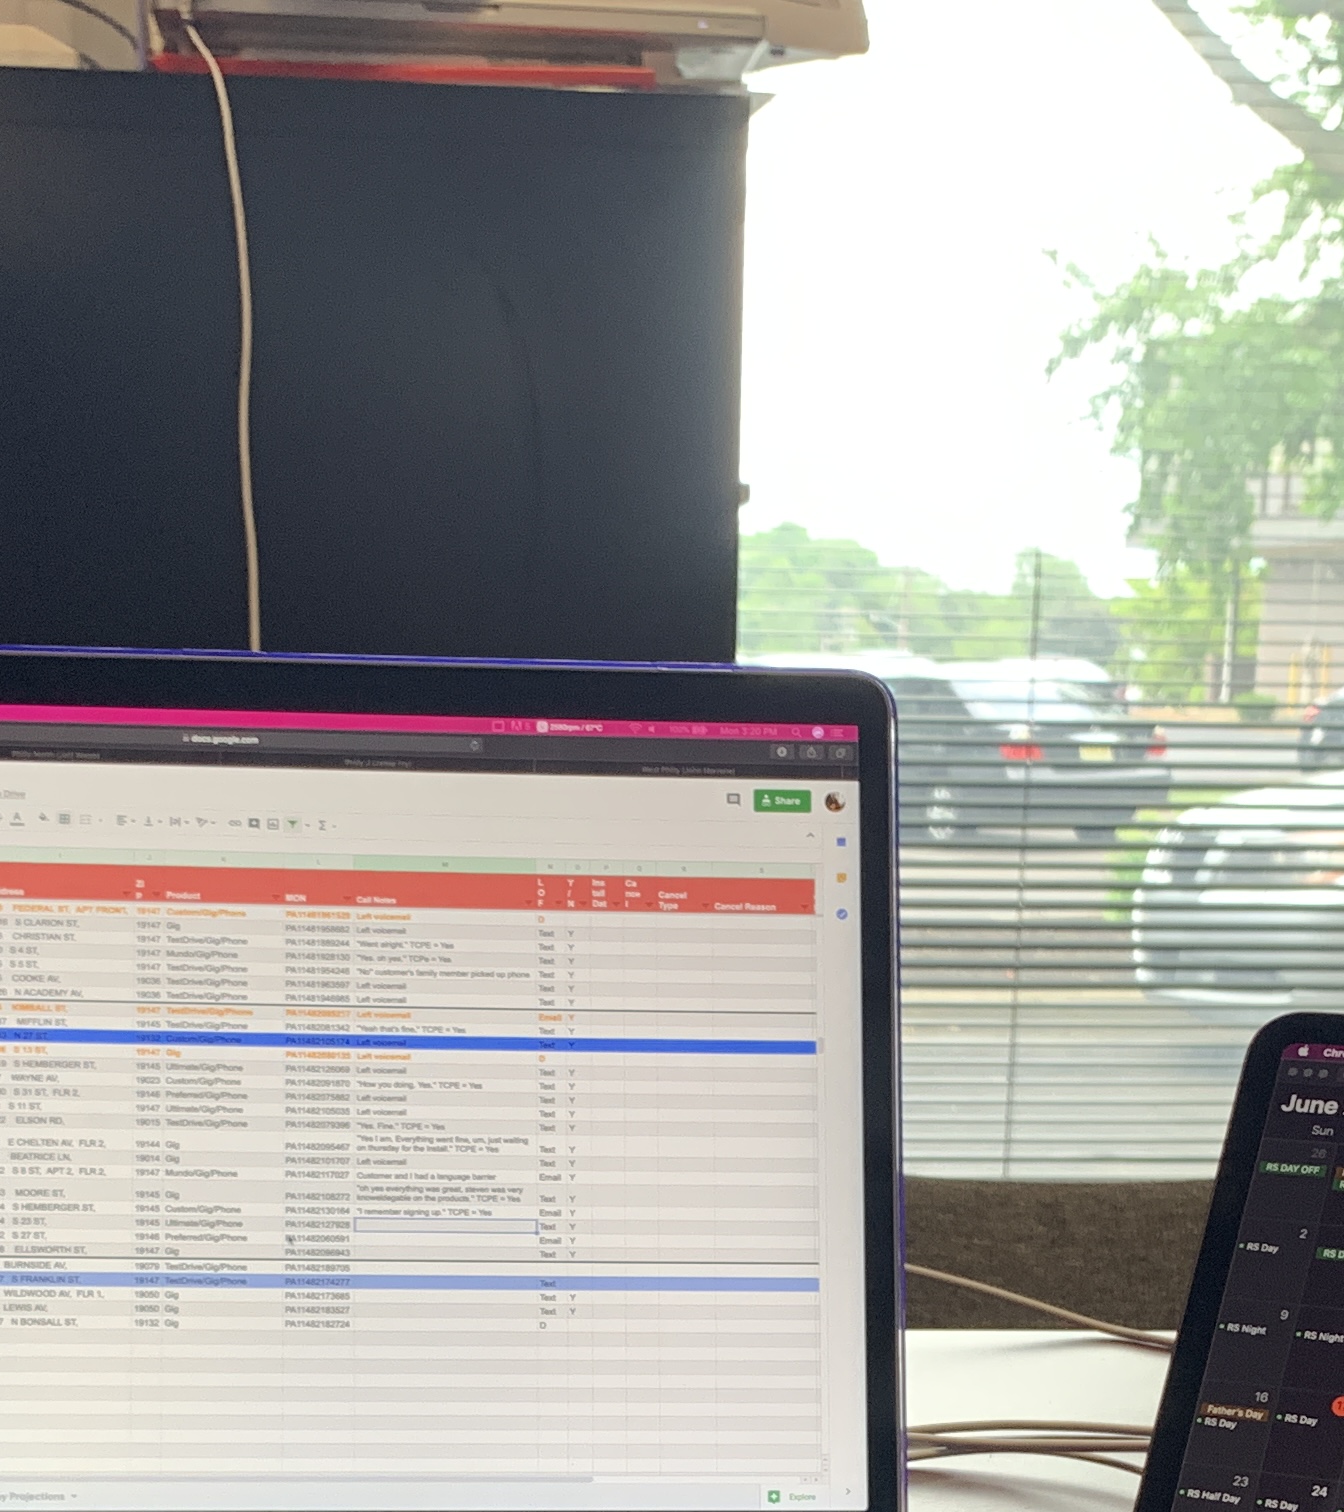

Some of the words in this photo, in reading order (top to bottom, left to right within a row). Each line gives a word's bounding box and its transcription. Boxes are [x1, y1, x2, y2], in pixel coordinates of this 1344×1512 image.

[775, 797, 800, 806] Share
[166, 891, 200, 900] Product
[715, 902, 743, 911] Cancel
[745, 903, 776, 911] Reason
[1281, 1094, 1338, 1115] June
[1312, 1125, 1334, 1136] Sun
[1233, 1476, 1249, 1487] 23
[1311, 1486, 1328, 1497] 24
[9, 1492, 65, 1503] Projections
